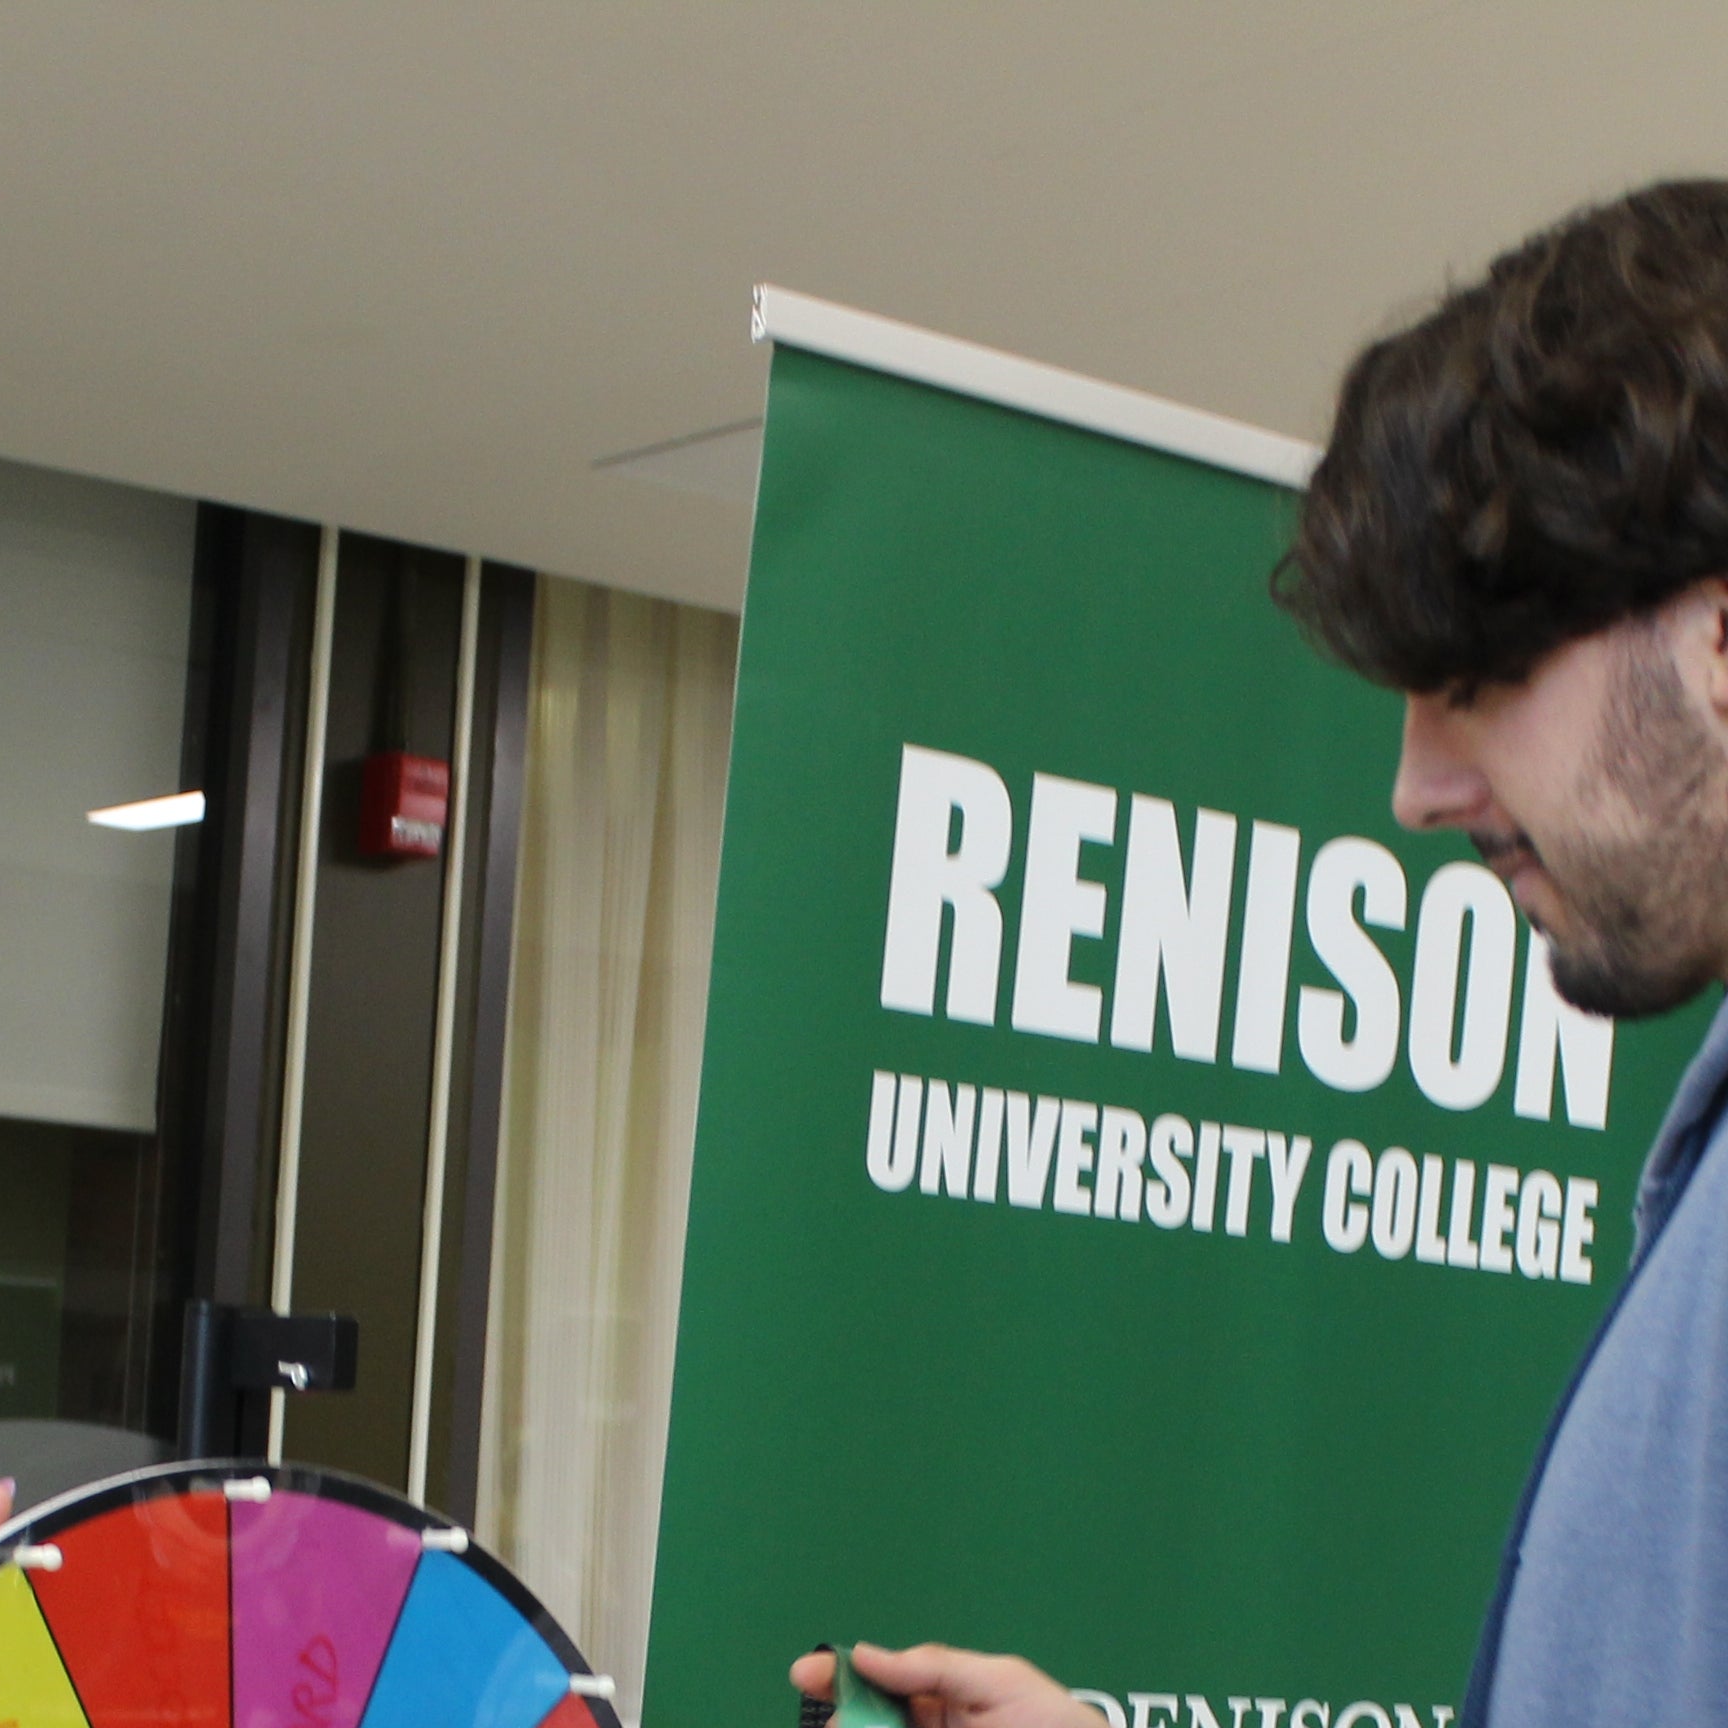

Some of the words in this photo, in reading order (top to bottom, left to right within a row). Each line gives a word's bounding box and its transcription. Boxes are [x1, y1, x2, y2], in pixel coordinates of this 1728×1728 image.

[879, 741, 1615, 1131] RENISON
[866, 1069, 1312, 1244] UNIVERSITY
[1322, 1137, 1599, 1285] COLLEGE
